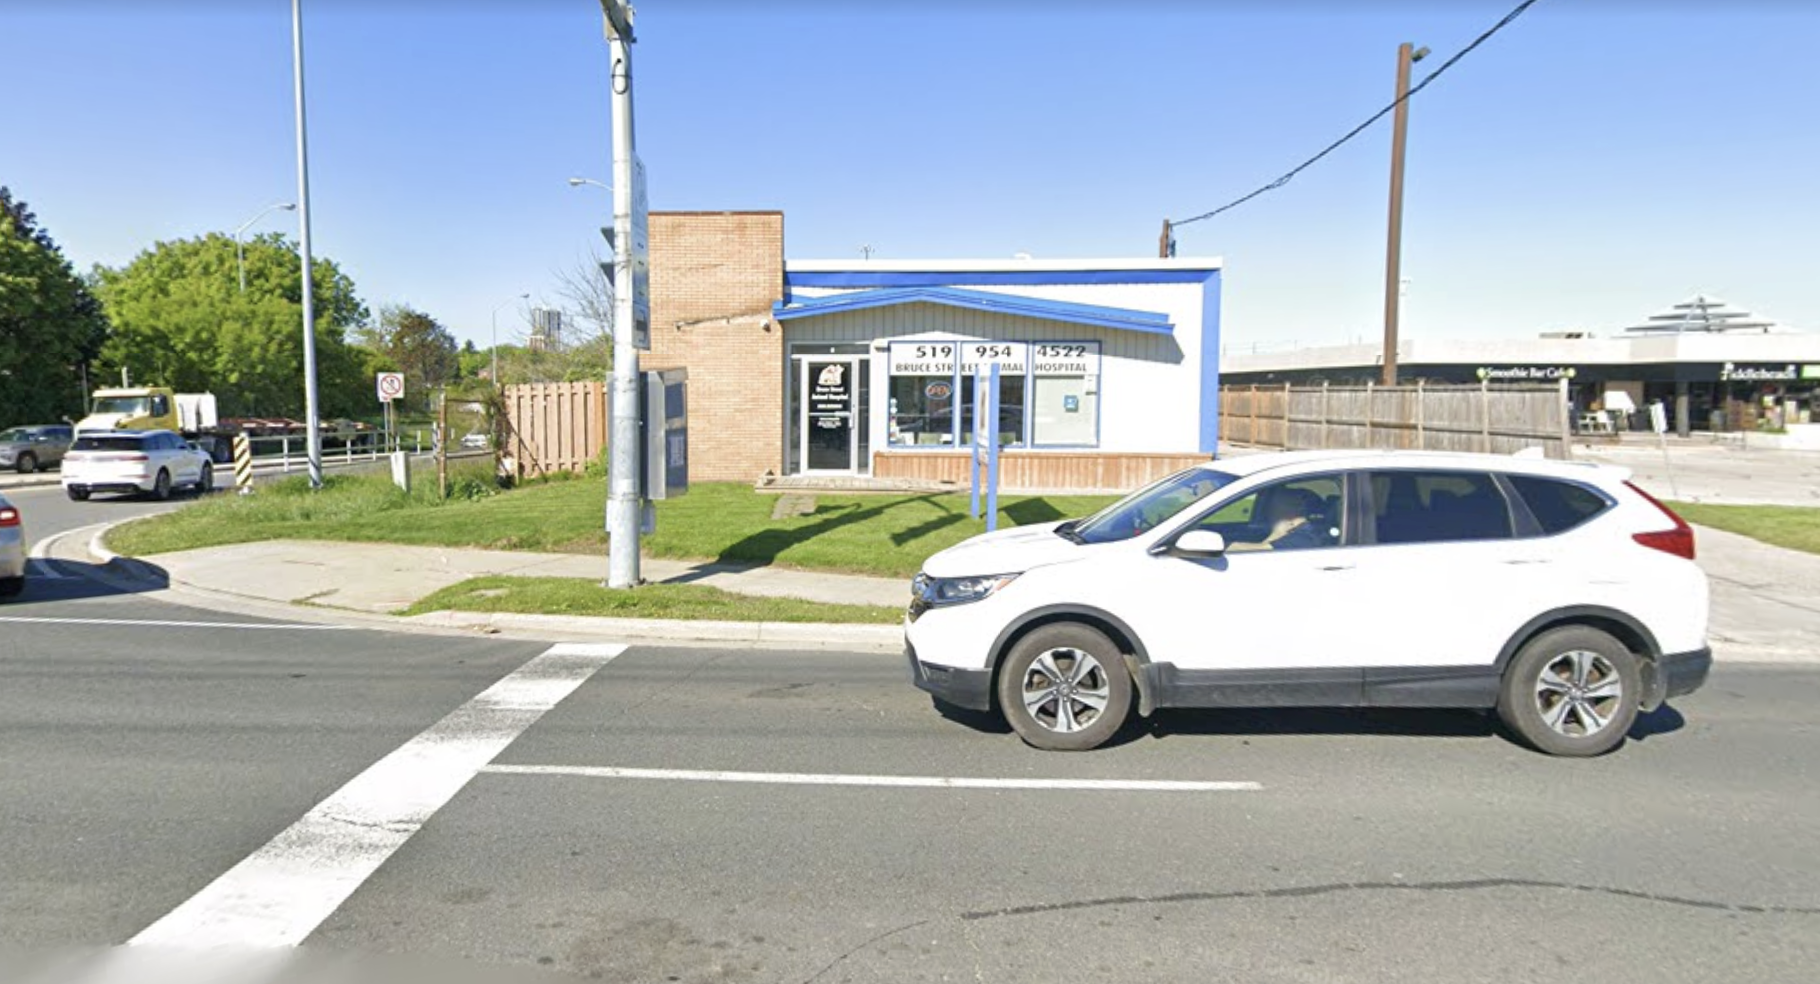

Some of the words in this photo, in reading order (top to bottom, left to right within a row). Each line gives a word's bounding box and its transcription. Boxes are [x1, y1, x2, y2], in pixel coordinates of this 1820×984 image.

[916, 345, 952, 358] 519
[975, 345, 1012, 358] 954
[1036, 345, 1086, 357] 4522
[895, 363, 931, 372] BRUCE
[1034, 363, 1087, 372] HOSPITAL
